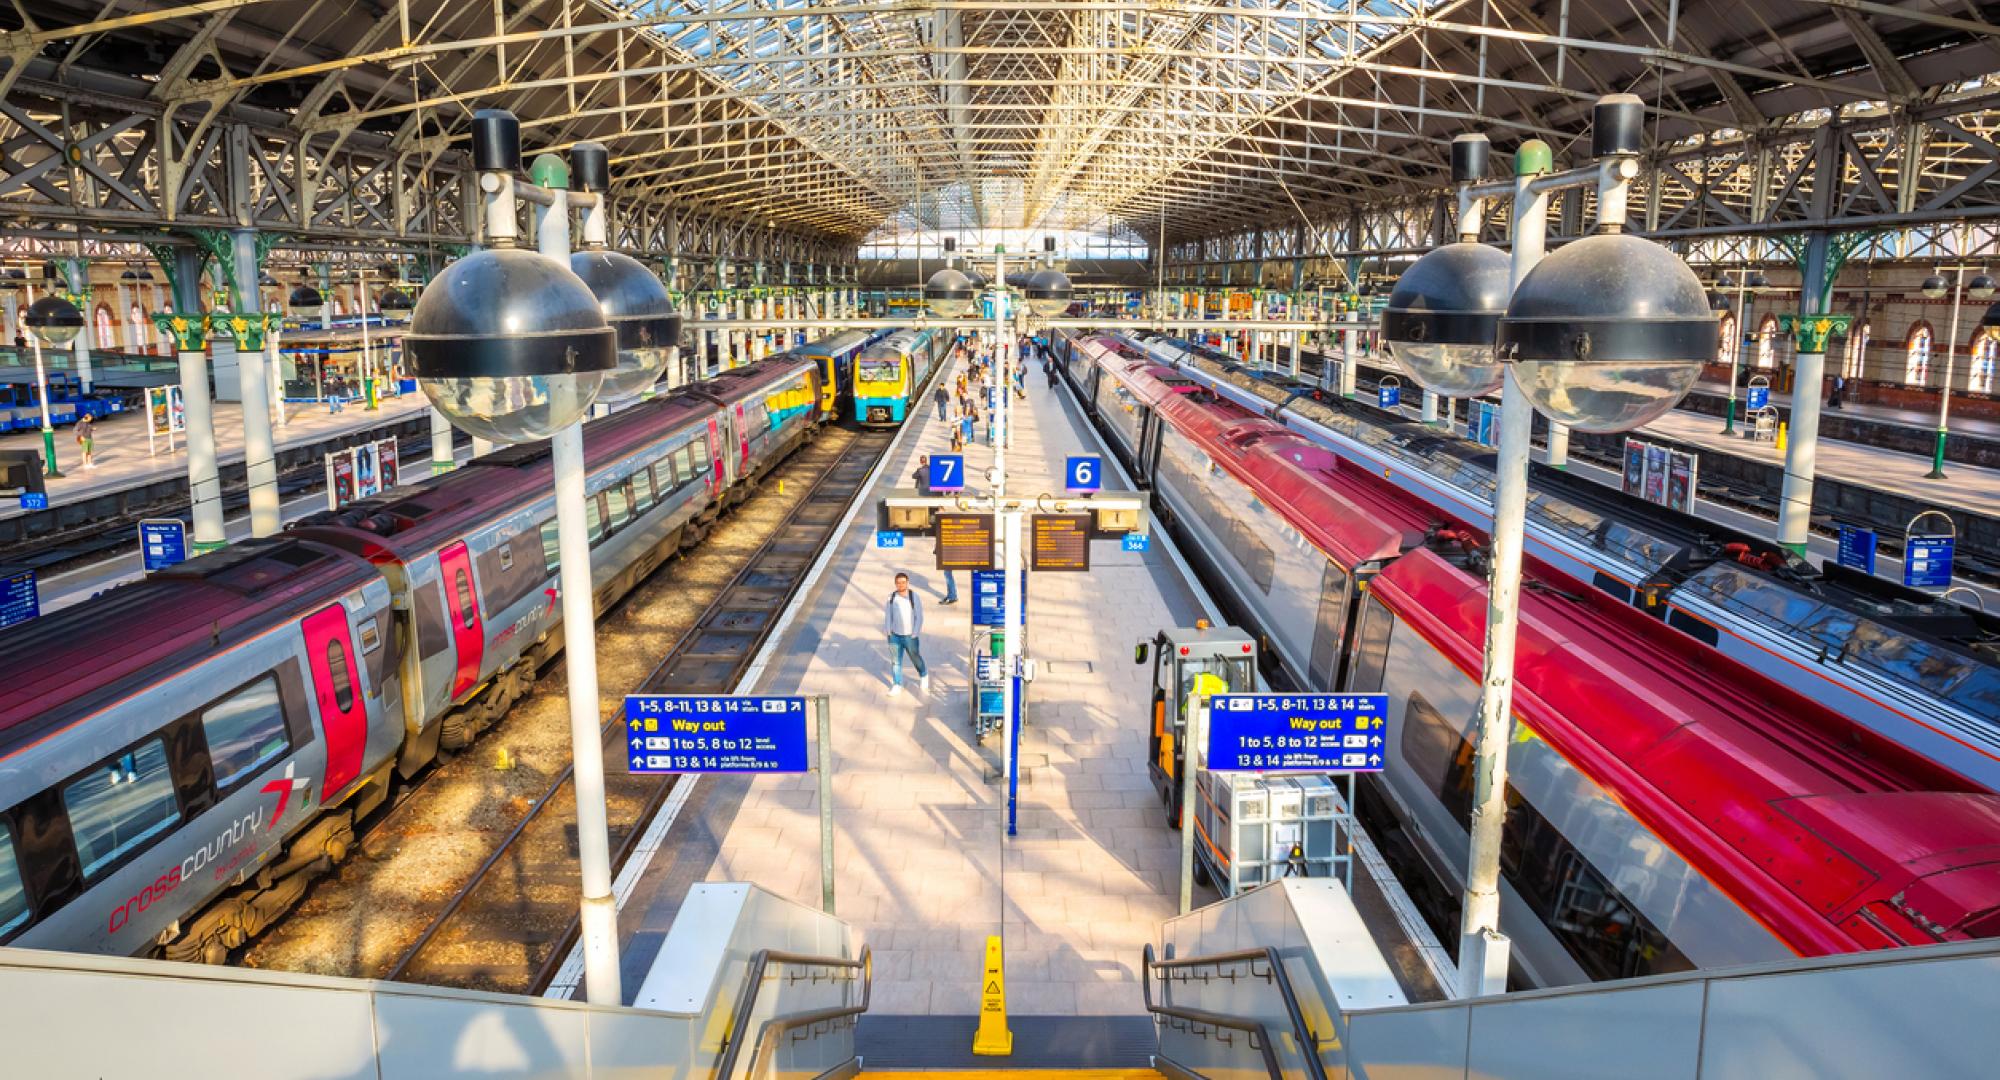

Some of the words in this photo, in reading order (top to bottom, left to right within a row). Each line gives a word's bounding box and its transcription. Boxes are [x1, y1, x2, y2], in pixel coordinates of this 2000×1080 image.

[940, 460, 956, 482] 7
[1075, 462, 1092, 483] 6
[639, 700, 662, 714] 1-5,
[664, 700, 692, 713] 8-11,
[695, 700, 708, 712] 13
[711, 700, 722, 712] &
[724, 700, 738, 712] 14
[1257, 699, 1279, 711] 1-5,
[1282, 699, 1309, 711] 8-11,
[1313, 699, 1325, 710] 13
[1328, 699, 1338, 710] &
[1341, 699, 1354, 710] 14
[672, 719, 700, 733] Way
[702, 720, 726, 731] out
[1290, 718, 1317, 731] Way
[1320, 718, 1342, 729] out
[673, 738, 679, 750] 1
[682, 738, 694, 750] to
[697, 738, 708, 750] 5,
[712, 738, 720, 750] 8
[723, 738, 736, 750] to
[739, 738, 752, 750] 12
[1239, 736, 1245, 747] 1
[1248, 736, 1260, 747] to
[1263, 736, 1274, 748] 5,
[1277, 736, 1286, 747] 8
[1289, 736, 1301, 747] to
[1304, 736, 1317, 747] 12
[674, 756, 687, 768] 13
[690, 756, 700, 768] &
[703, 756, 716, 768] 14
[1238, 755, 1250, 766] 13
[1253, 755, 1263, 766] &
[1266, 755, 1279, 766] 14
